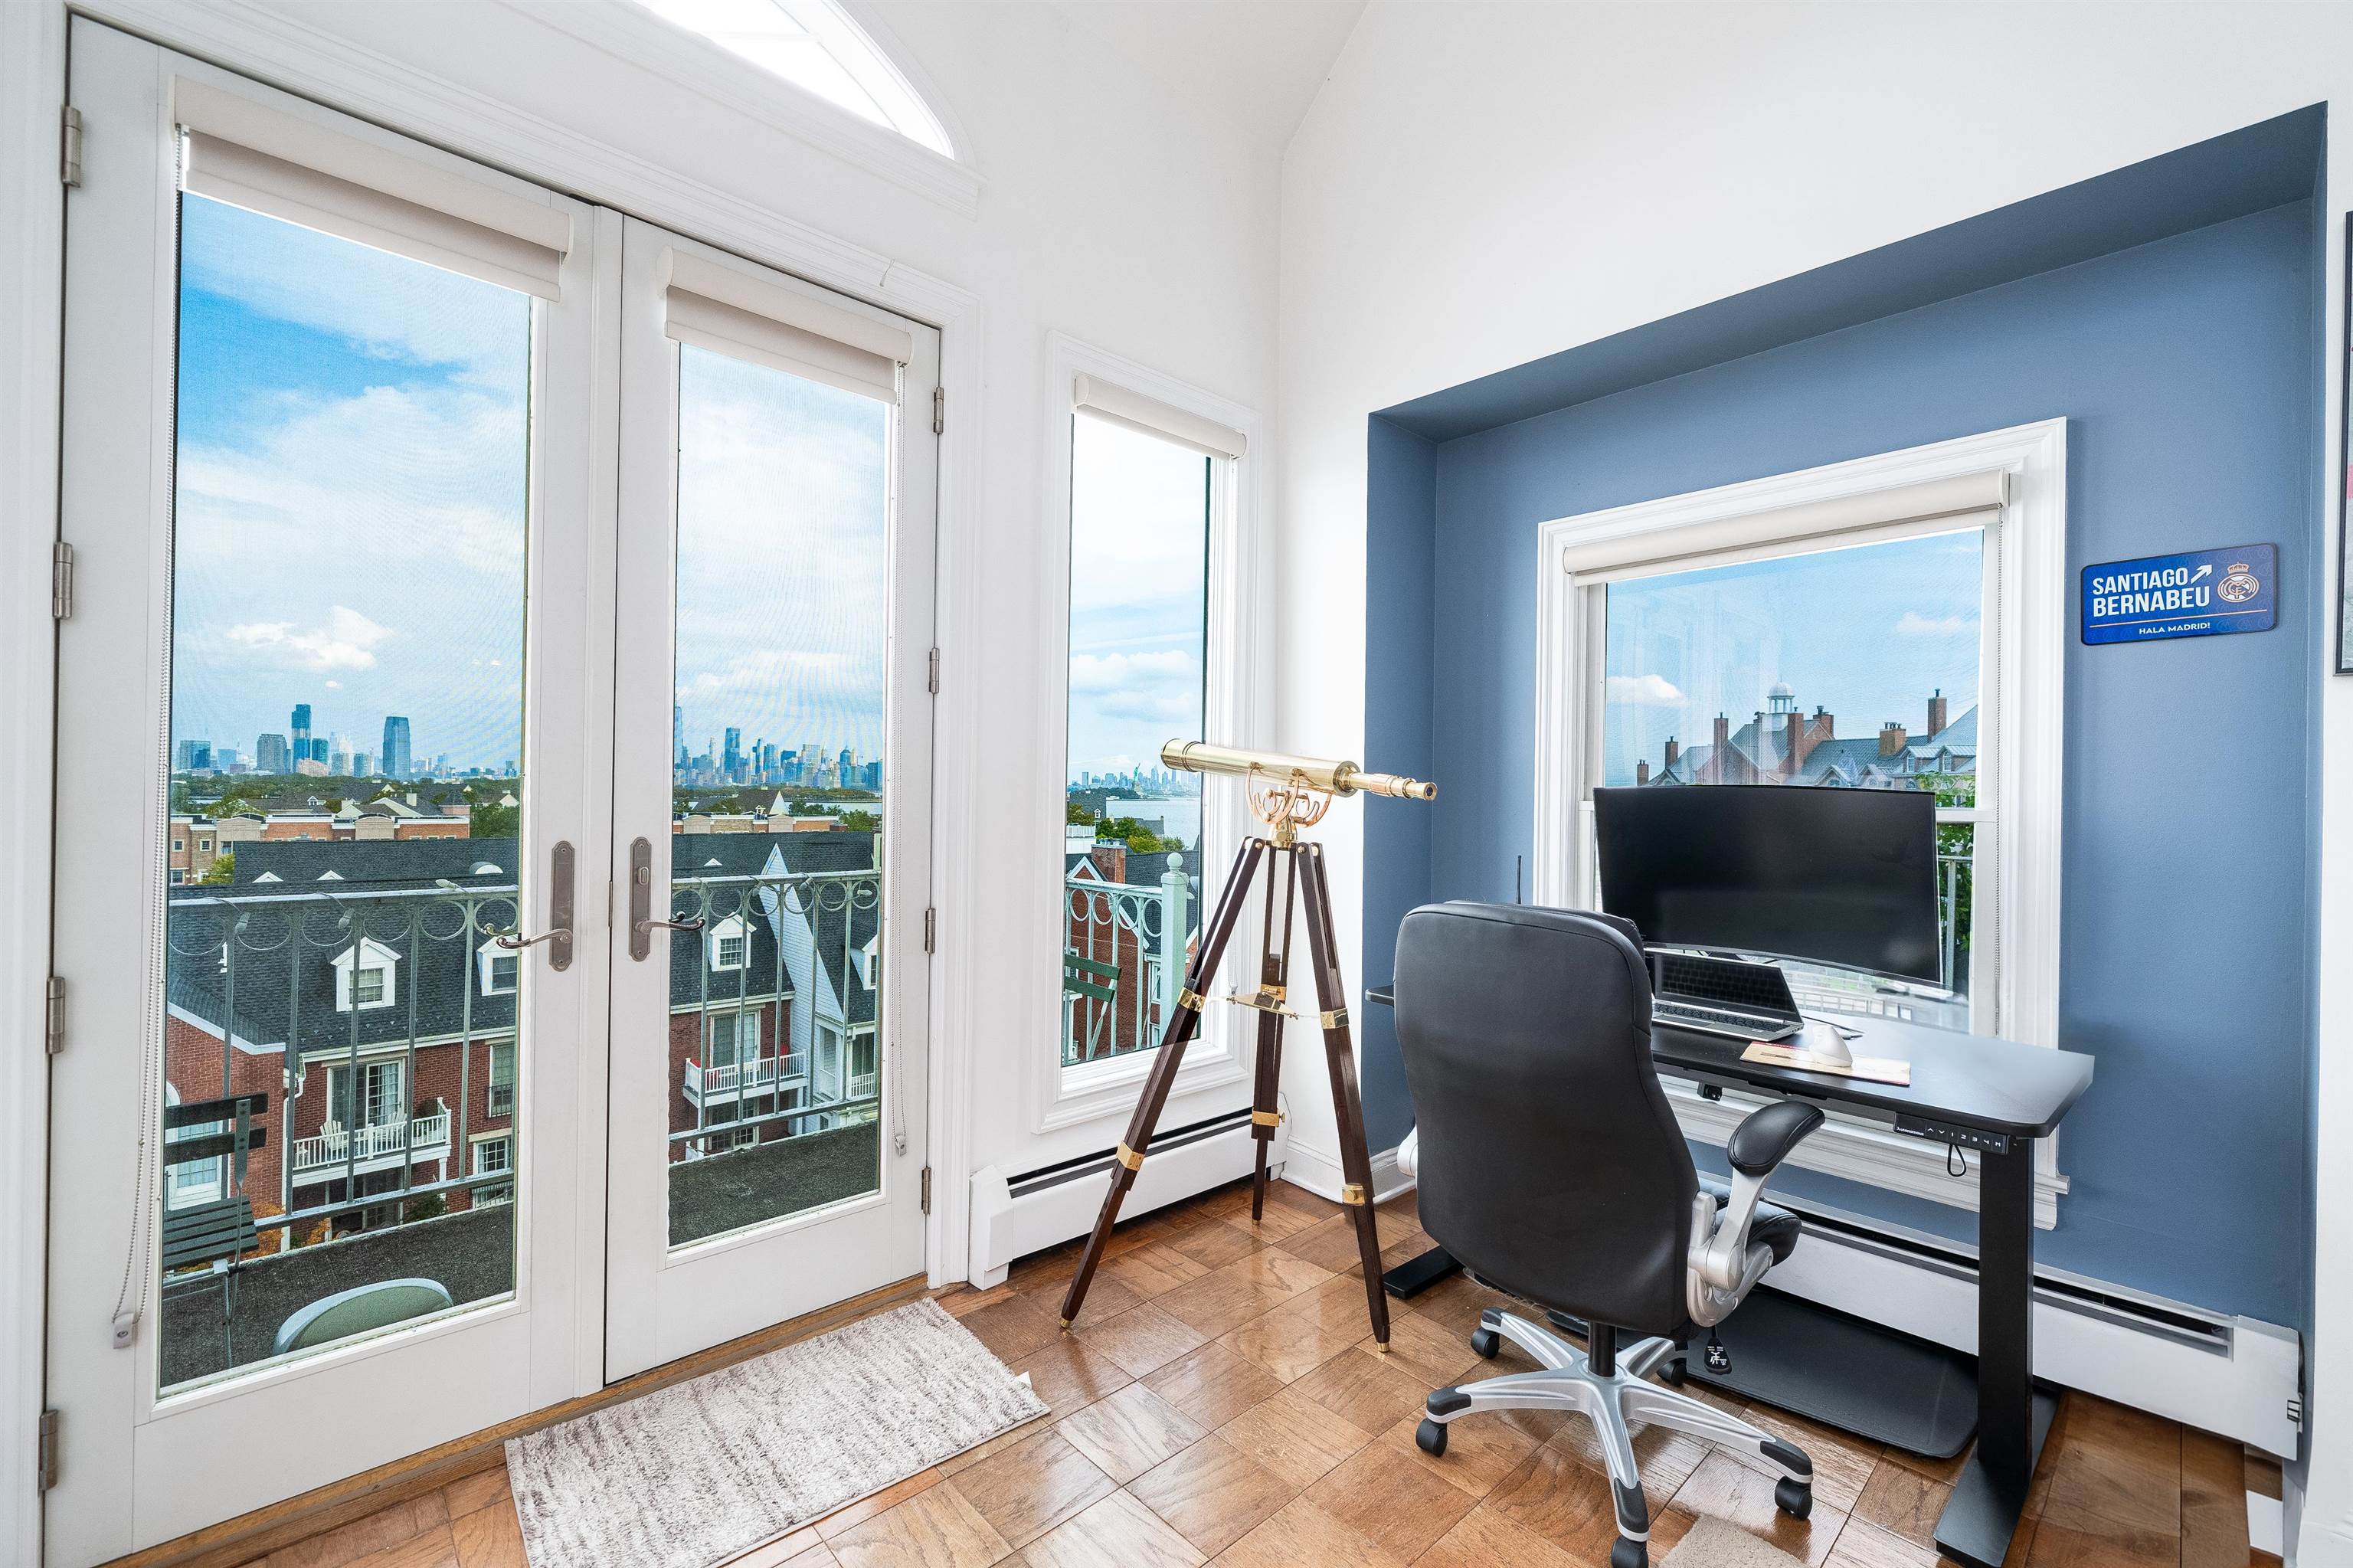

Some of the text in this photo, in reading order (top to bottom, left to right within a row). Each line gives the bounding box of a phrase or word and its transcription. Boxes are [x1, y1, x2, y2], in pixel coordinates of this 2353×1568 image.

[2093, 567, 2188, 595] SANTIAGO
[2093, 586, 2210, 617] BERNABEU
[2168, 622, 2211, 632] MADRID!
